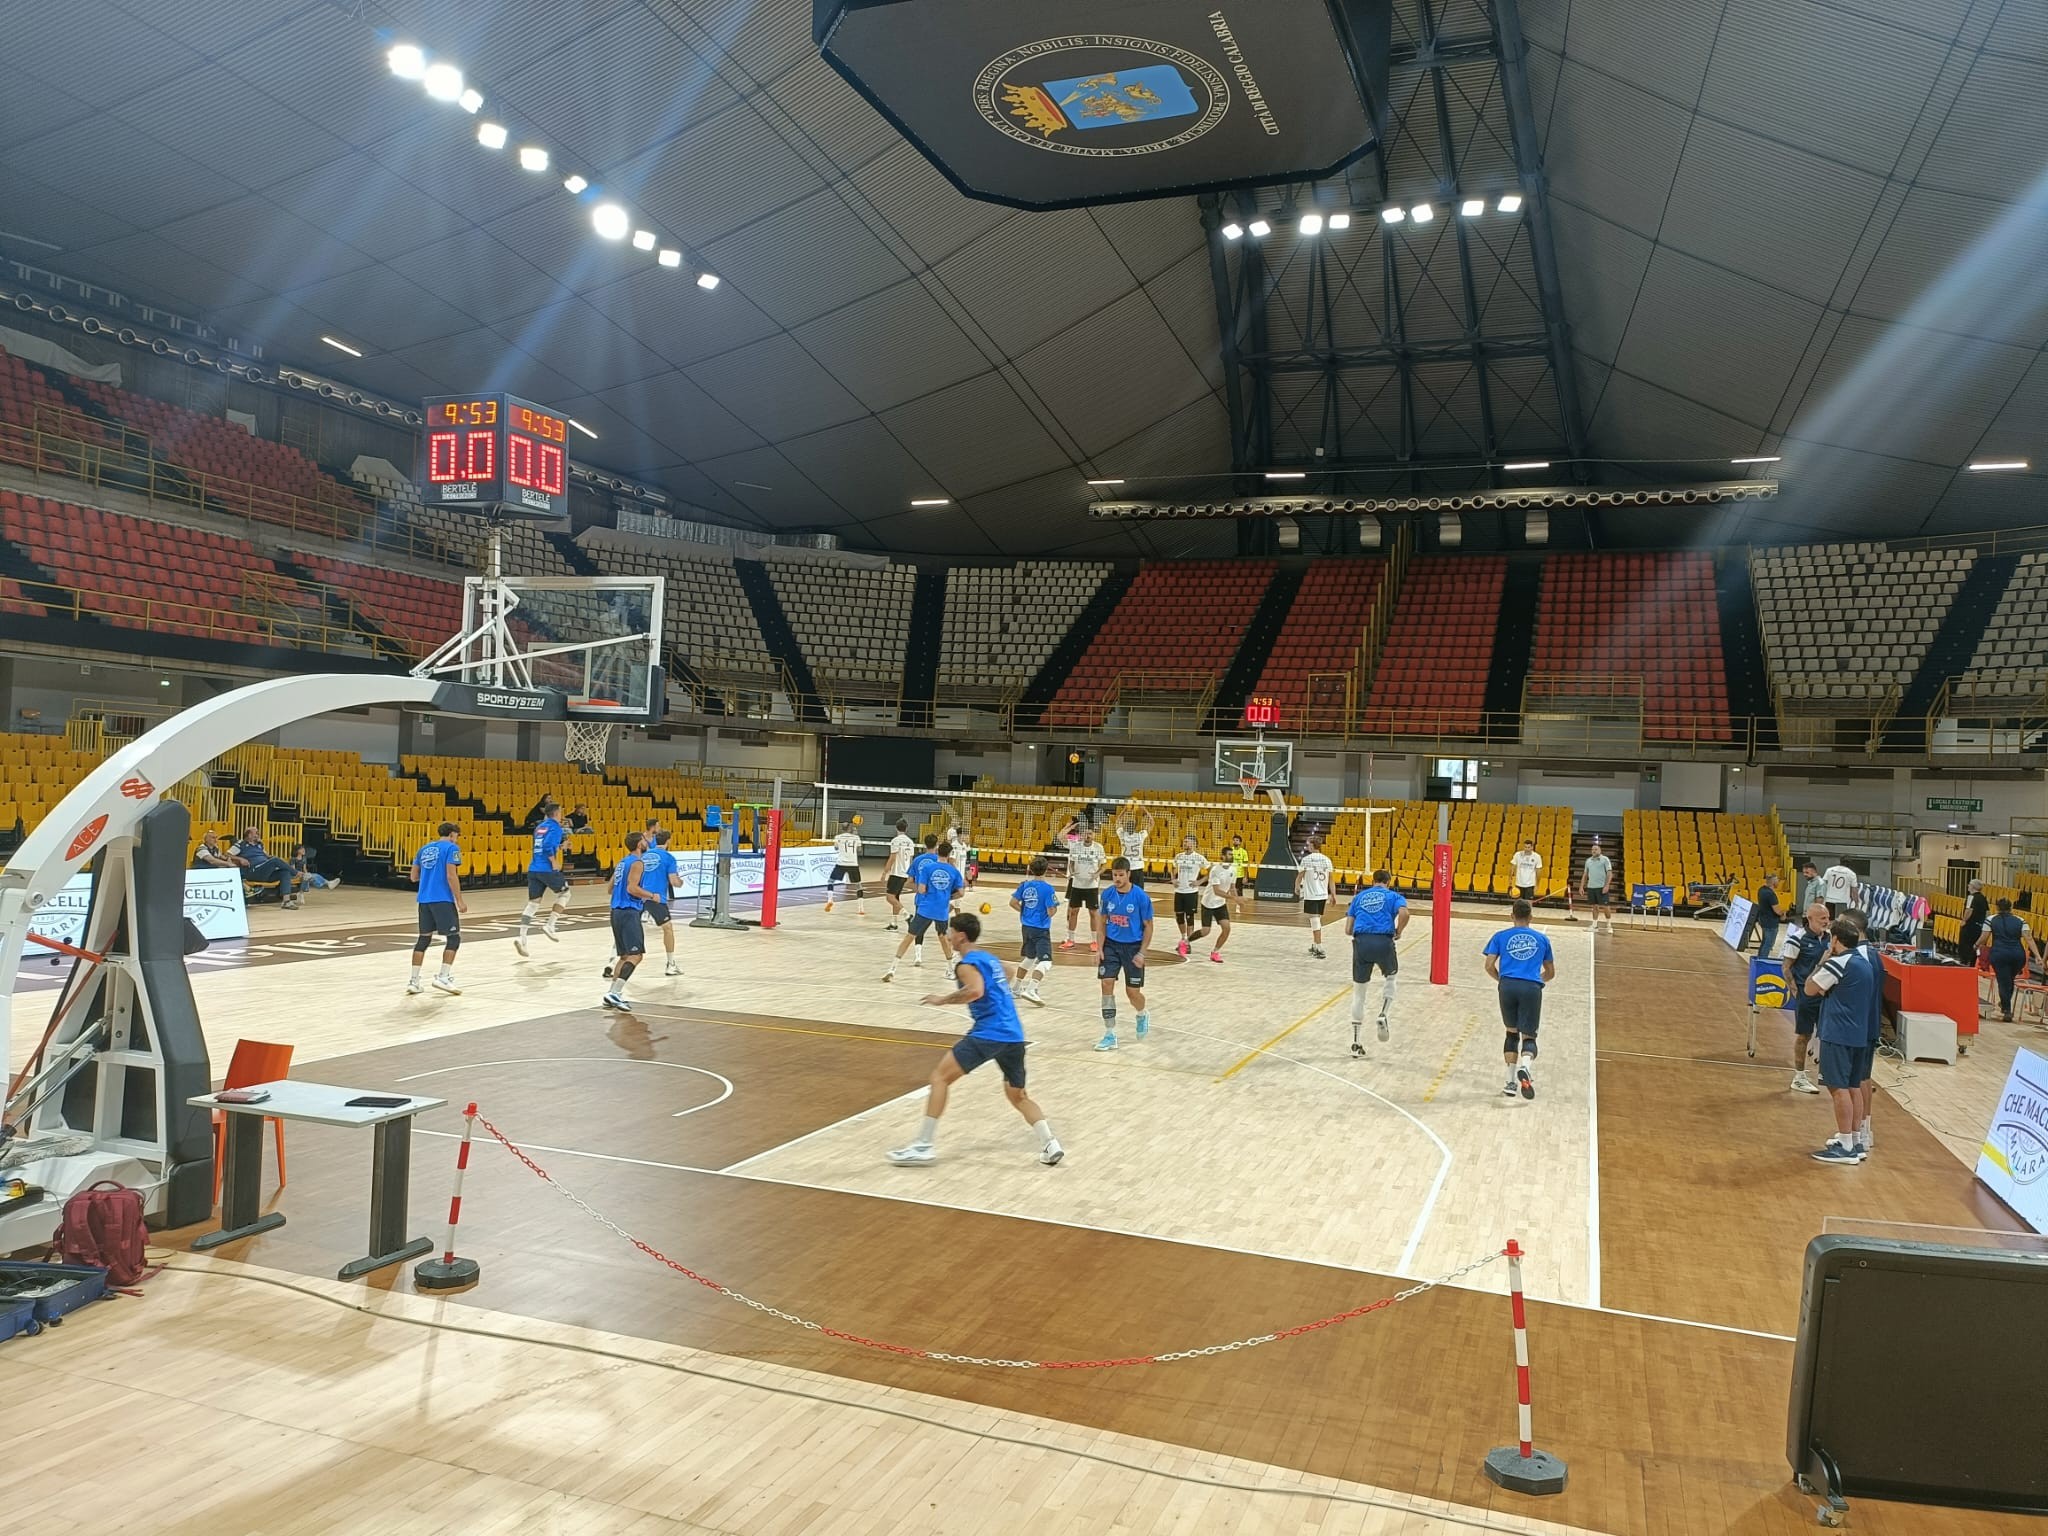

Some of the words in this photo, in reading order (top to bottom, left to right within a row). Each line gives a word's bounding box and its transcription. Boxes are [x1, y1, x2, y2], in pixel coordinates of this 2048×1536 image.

[1208, 10, 1244, 64] CALABRIA
[1233, 64, 1263, 101] REGGIO
[1251, 99, 1270, 112] DI
[1253, 109, 1281, 136] CITTÀ
[445, 401, 497, 425] 9:53
[522, 408, 566, 442] 9:53
[1253, 697, 1273, 706] 9:53
[72, 822, 100, 855] ACE
[844, 840, 856, 854] 14
[1831, 874, 1846, 889] 10
[2005, 1093, 2026, 1114] CHE
